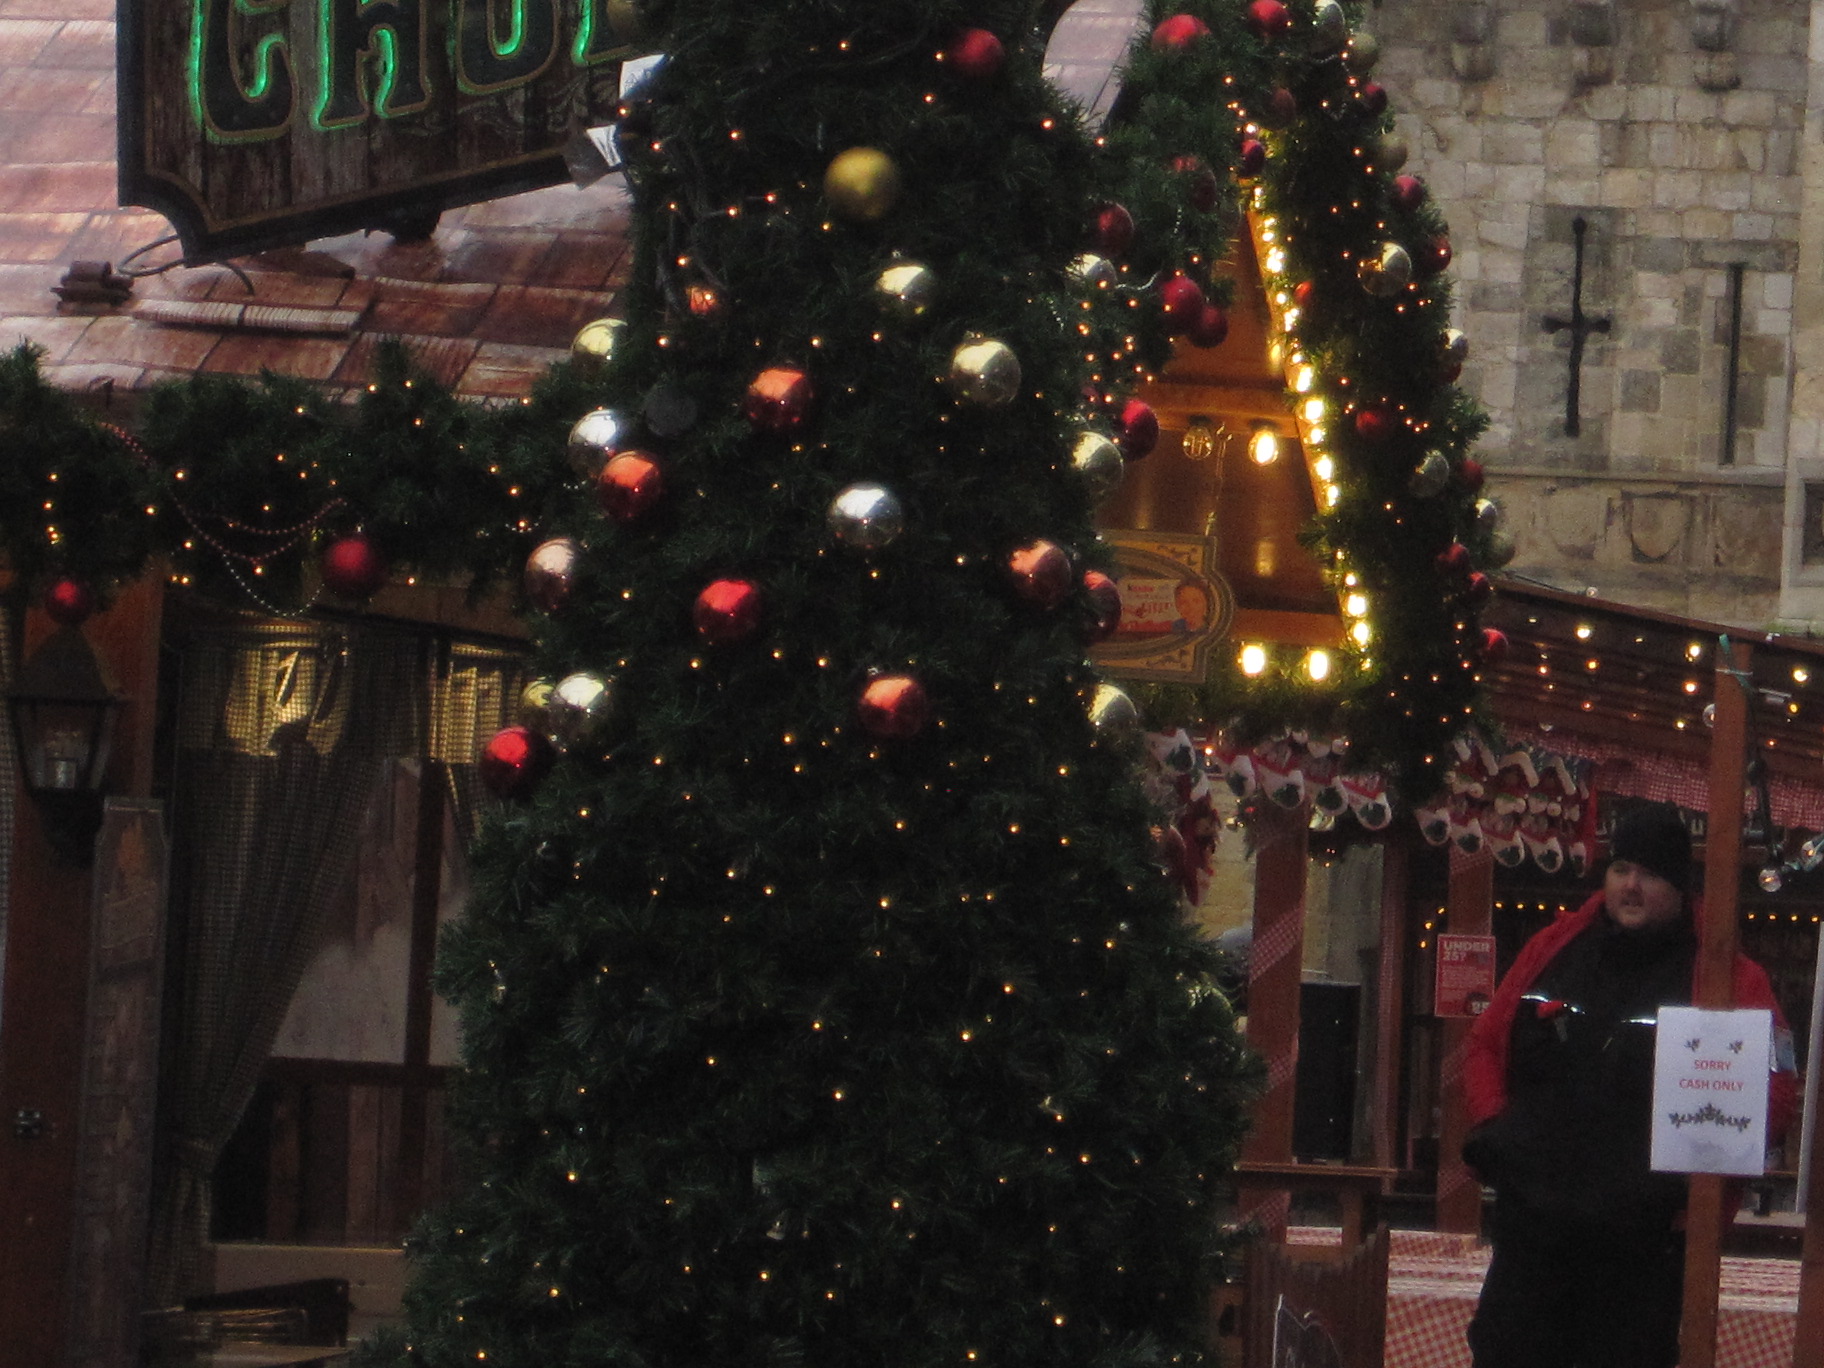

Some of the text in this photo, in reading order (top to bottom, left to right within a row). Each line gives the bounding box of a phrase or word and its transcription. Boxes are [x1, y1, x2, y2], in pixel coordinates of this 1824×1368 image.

[1443, 941, 1490, 952] UNDER
[1694, 1060, 1731, 1070] SORRY
[1679, 1078, 1744, 1091] CASH ONLY
